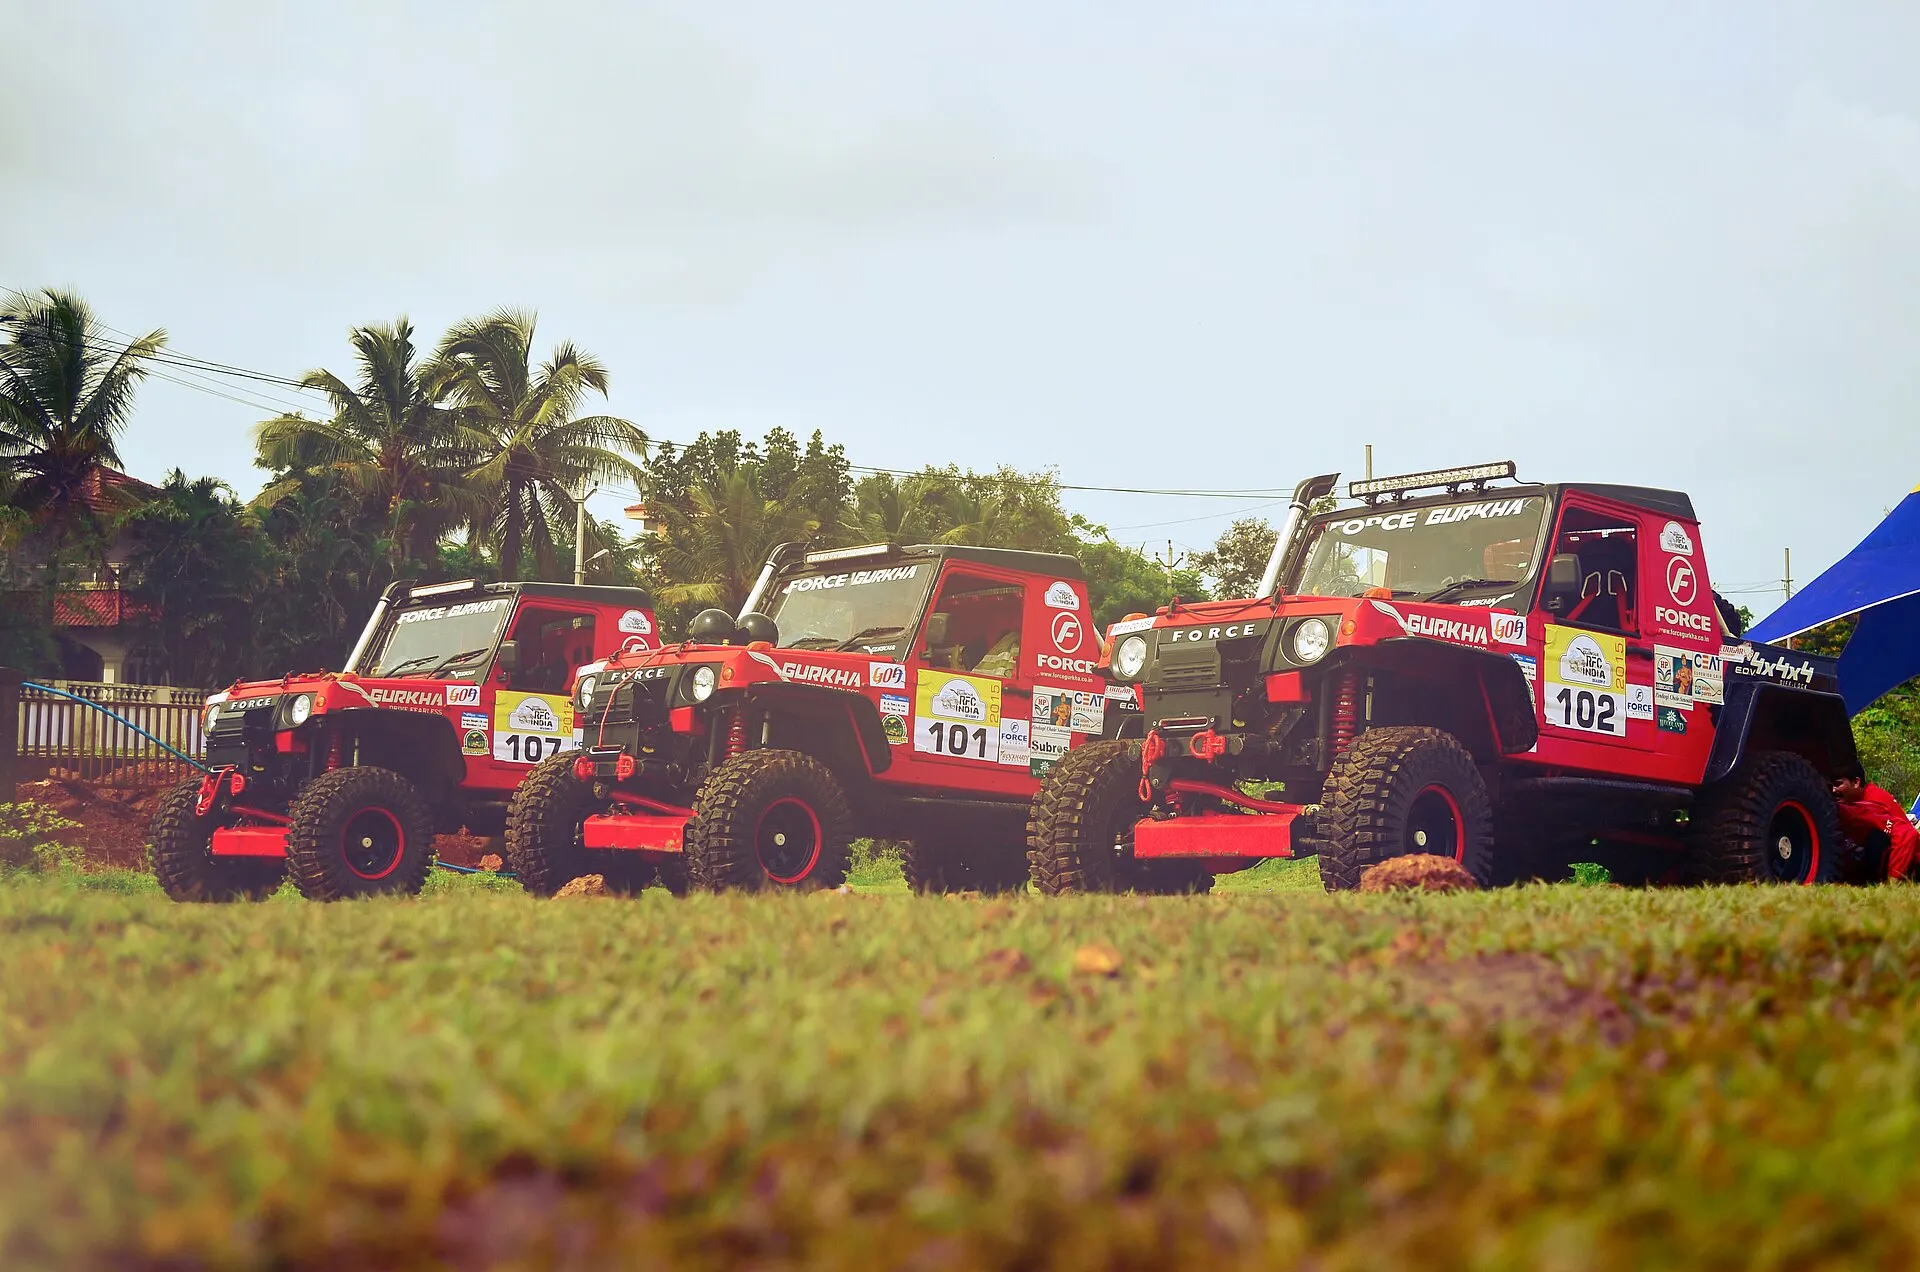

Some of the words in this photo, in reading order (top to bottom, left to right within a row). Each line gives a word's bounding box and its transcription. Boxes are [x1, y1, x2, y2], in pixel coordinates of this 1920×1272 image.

[1329, 512, 1418, 535] FORCE
[1425, 499, 1525, 526] GURKHA
[782, 574, 848, 594] FORCE
[850, 565, 918, 585] GURKHA
[397, 607, 447, 624] FORCE
[446, 600, 498, 617] GURKHA
[1655, 606, 1711, 632] FORCE
[1172, 624, 1255, 642] FORCE
[1407, 614, 1488, 644] GURKHA
[1494, 619, 1524, 640] GOA
[1037, 654, 1096, 673] FORCE
[1586, 655, 1602, 668] RFC
[1614, 642, 1625, 690] 2015
[1660, 660, 1669, 668] HP
[1694, 654, 1722, 671] CEAT
[611, 668, 665, 681] FORCE
[781, 662, 861, 687] GURKHA
[871, 667, 904, 684] GOA
[1582, 667, 1605, 679] INDIA
[370, 688, 443, 706] GURKHA
[449, 687, 478, 702] GOA
[959, 696, 976, 706] RFC
[1074, 692, 1104, 707] CEAT
[231, 698, 272, 710] FORCE
[955, 705, 980, 715] INDIA
[989, 685, 1000, 723] 2015
[1556, 688, 1615, 732] 102
[1627, 702, 1652, 712] FORCE
[530, 719, 553, 727] INDIA
[534, 710, 550, 720] RFC
[563, 701, 572, 734] 2015
[928, 722, 987, 758] 101
[1001, 733, 1028, 742] FORCE
[505, 734, 562, 762] 107
[1031, 740, 1068, 753] Subros
